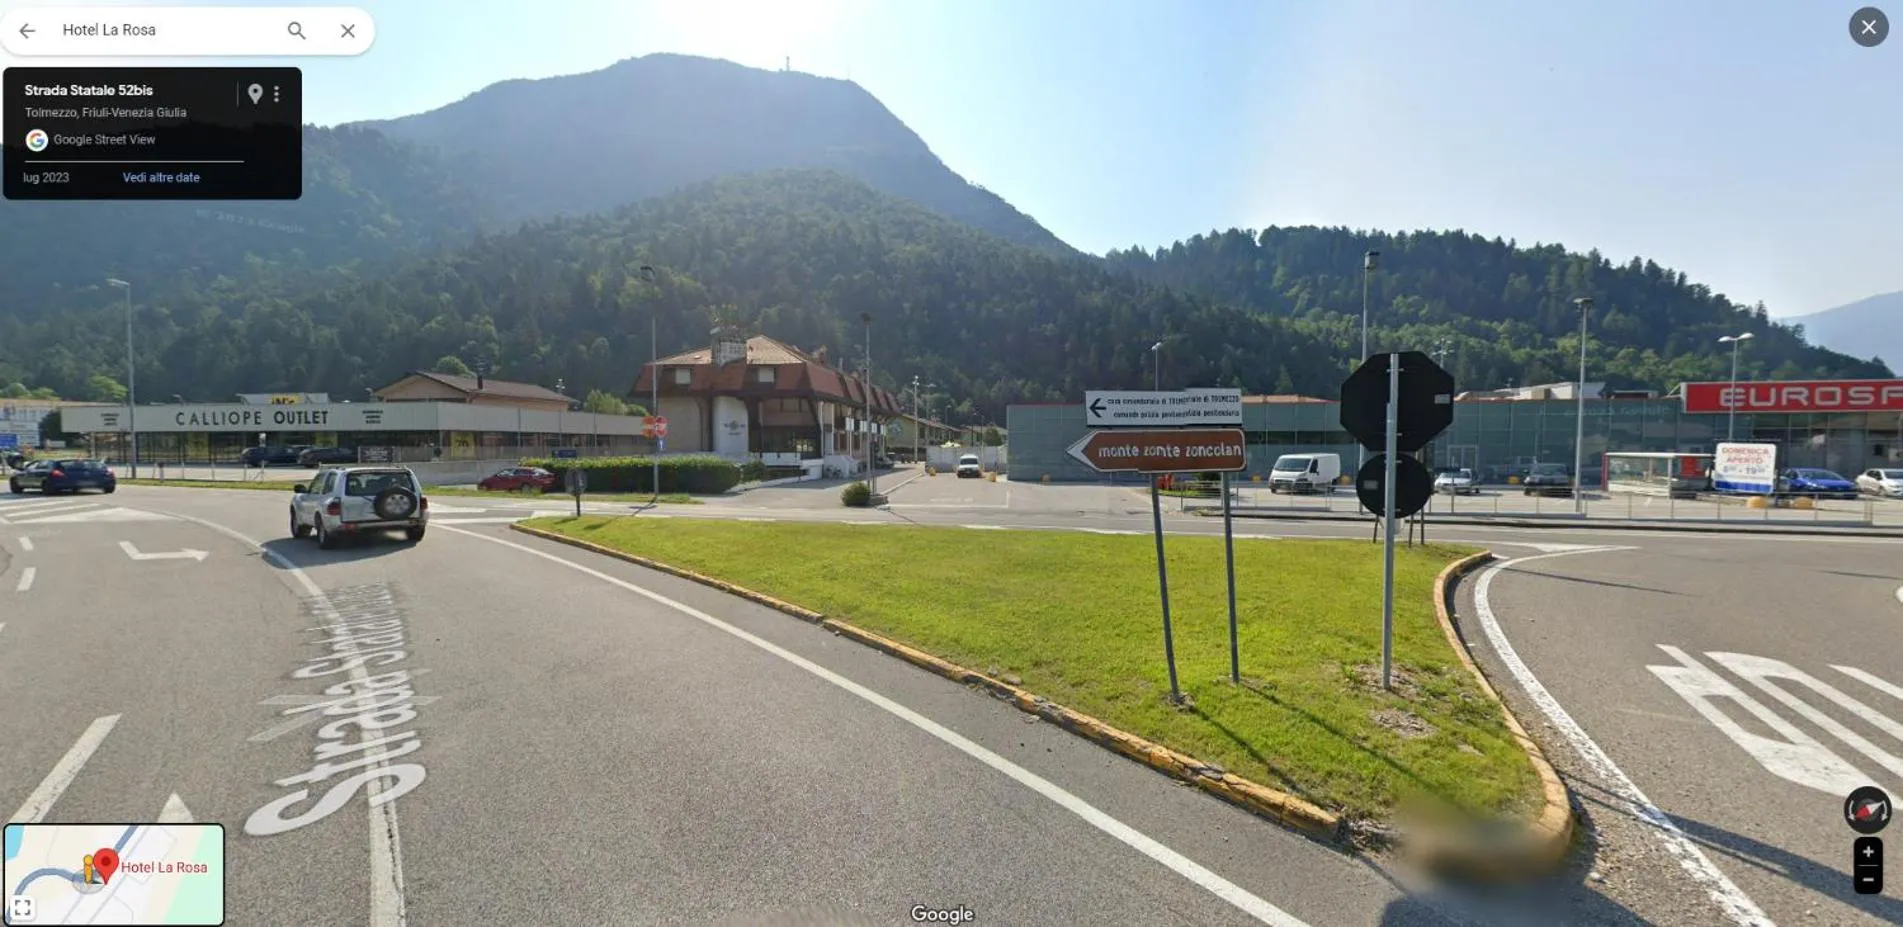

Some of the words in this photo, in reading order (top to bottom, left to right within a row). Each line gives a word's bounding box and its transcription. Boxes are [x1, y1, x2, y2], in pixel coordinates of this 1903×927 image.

[175, 410, 263, 426] CALLIOPE
[273, 410, 329, 425] OUTLET
[1098, 445, 1139, 458] monte
[1185, 442, 1242, 458] zoncolan
[1721, 447, 1769, 455] DOMENICA
[1726, 456, 1764, 465] APERTO
